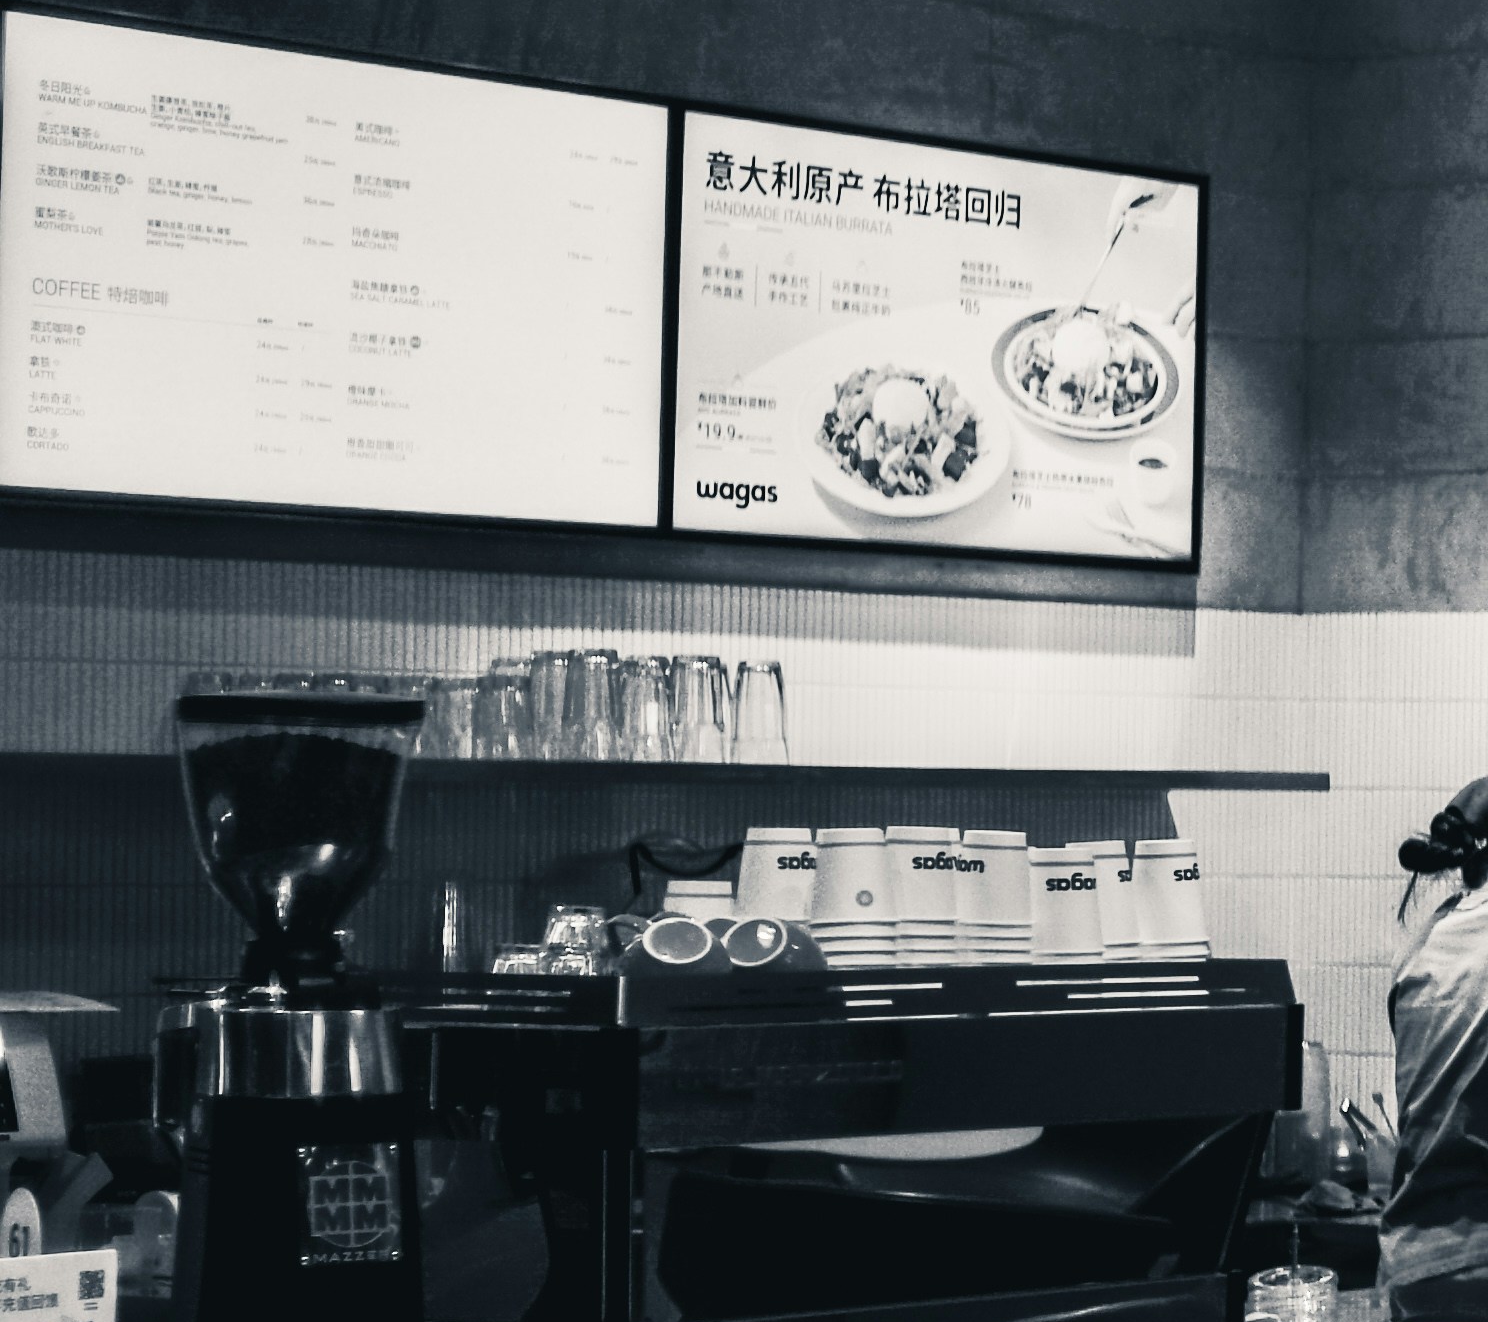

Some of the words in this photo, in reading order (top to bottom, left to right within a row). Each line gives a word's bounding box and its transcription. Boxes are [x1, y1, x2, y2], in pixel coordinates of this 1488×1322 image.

[39, 93, 66, 105] WARM
[68, 98, 81, 107] ME
[83, 100, 96, 108] UP
[98, 101, 148, 115] KOMBUCHA
[37, 135, 75, 148] ENGLISH
[77, 140, 127, 154] BREAKFAST
[130, 146, 144, 156] TEA
[35, 177, 69, 189] GINGER
[70, 182, 101, 193] LEMON
[104, 186, 120, 195] TEA
[706, 151, 864, 205] 意大利原产
[873, 174, 1021, 230] 布拉塔回归
[704, 198, 779, 221] HANDMADE
[783, 208, 832, 228] ITALIAN
[835, 214, 893, 236] BURRATA
[82, 226, 104, 237] LOVE
[32, 277, 101, 301] COFFEE
[107, 286, 169, 307] 特焙咖啡
[30, 334, 51, 344] FLAT
[54, 336, 82, 347] WHITE
[29, 369, 56, 380] LATTE
[28, 405, 85, 417] CAPPUCCINO
[27, 440, 69, 452] CORTADO
[696, 480, 778, 509] wagas
[1046, 872, 1096, 891] agas
